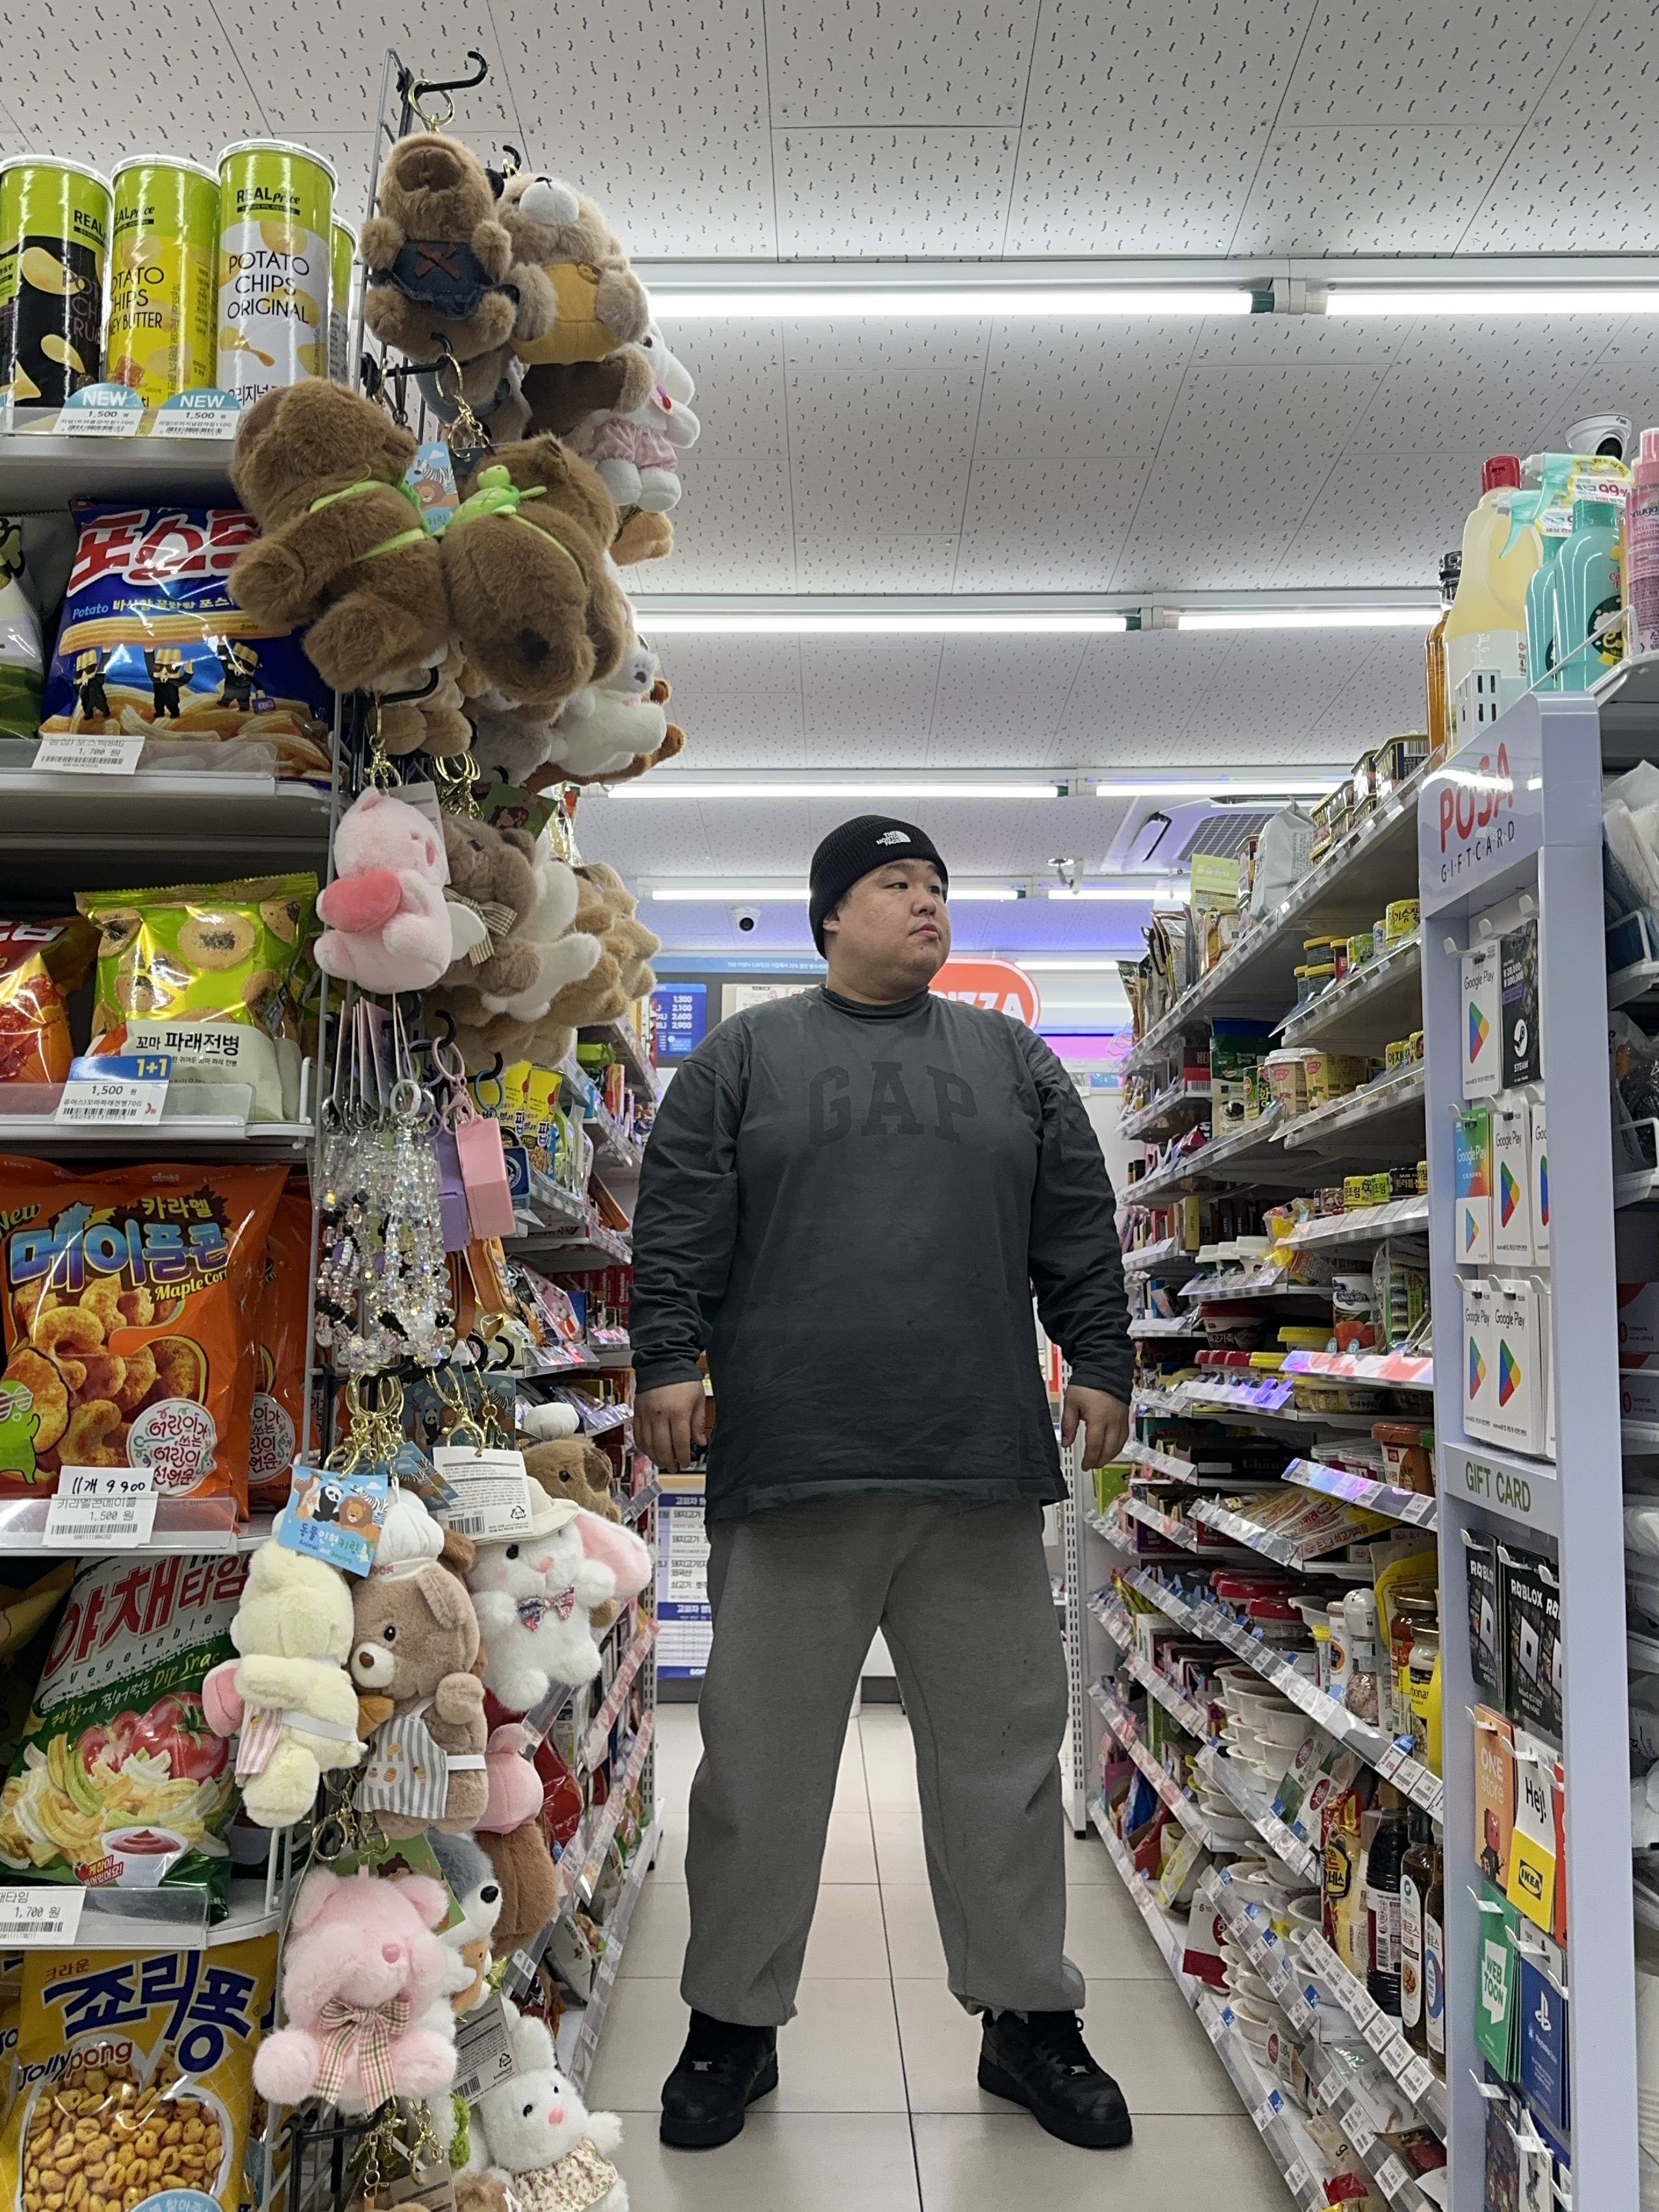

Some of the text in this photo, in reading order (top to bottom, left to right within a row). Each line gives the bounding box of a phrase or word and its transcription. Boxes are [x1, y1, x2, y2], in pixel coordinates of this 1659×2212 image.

[230, 251, 309, 276] POTATO
[111, 267, 165, 295] OTATO
[236, 275, 296, 296] CHIPS
[111, 289, 149, 314] HIPS
[228, 298, 309, 325] ORIGINAL
[122, 312, 163, 330] BUTTER
[82, 391, 128, 407] NEW
[180, 395, 225, 408] NEW
[73, 604, 109, 620] Potato
[1464, 970, 1494, 990] Google Play
[928, 991, 1027, 1024] ZZA
[136, 1032, 240, 1056] 꼬마 파래전병
[136, 1058, 168, 1077] 1+1
[1514, 1059, 1529, 1072] STEAM
[92, 1086, 123, 1095] 1,500
[809, 1060, 977, 1148] GAP
[1496, 1130, 1522, 1149] Google Play
[1457, 1145, 1487, 1165] Google Play
[1372, 1182, 1386, 1195] 조림
[141, 1196, 213, 1220] 카라멜
[10, 1210, 228, 1293] 메이플콘
[155, 1279, 204, 1301] Maple
[1465, 1308, 1490, 1328] Google Play
[1495, 1309, 1525, 1330] Google Play
[150, 1415, 208, 1438] 어린이가
[179, 1434, 202, 1447] 쓰는
[250, 1436, 276, 1455] 린이
[154, 1445, 201, 1468] 어린이
[72, 1476, 98, 1495] 11개
[154, 1466, 195, 1488] 선언문
[1466, 1461, 1531, 1512] GIFT CARD
[57, 1497, 137, 1509] 카라멜콘메이플
[90, 1510, 134, 1521] 1,500 원
[299, 1539, 319, 1551] Animal
[371, 1564, 394, 1575] OOK
[1511, 1578, 1543, 1609] ROBLOX
[43, 1555, 250, 1680] 야채타임
[154, 1665, 179, 1690] Dip
[180, 1652, 221, 1677] Snac
[1480, 1747, 1504, 1782] ONE
[1481, 1775, 1504, 1805] store
[1525, 1777, 1547, 1823] Hej!
[1520, 1867, 1540, 1891] IKEA
[0, 1891, 29, 1904] 타임
[15, 1906, 61, 1918] 1,700 원
[45, 1958, 90, 1984] 크라운
[1487, 1954, 1502, 1984] WEB
[1484, 1971, 1504, 2007] TOON
[42, 1950, 258, 2072] 죠리퐁
[19, 2041, 133, 2092] Jollypong
